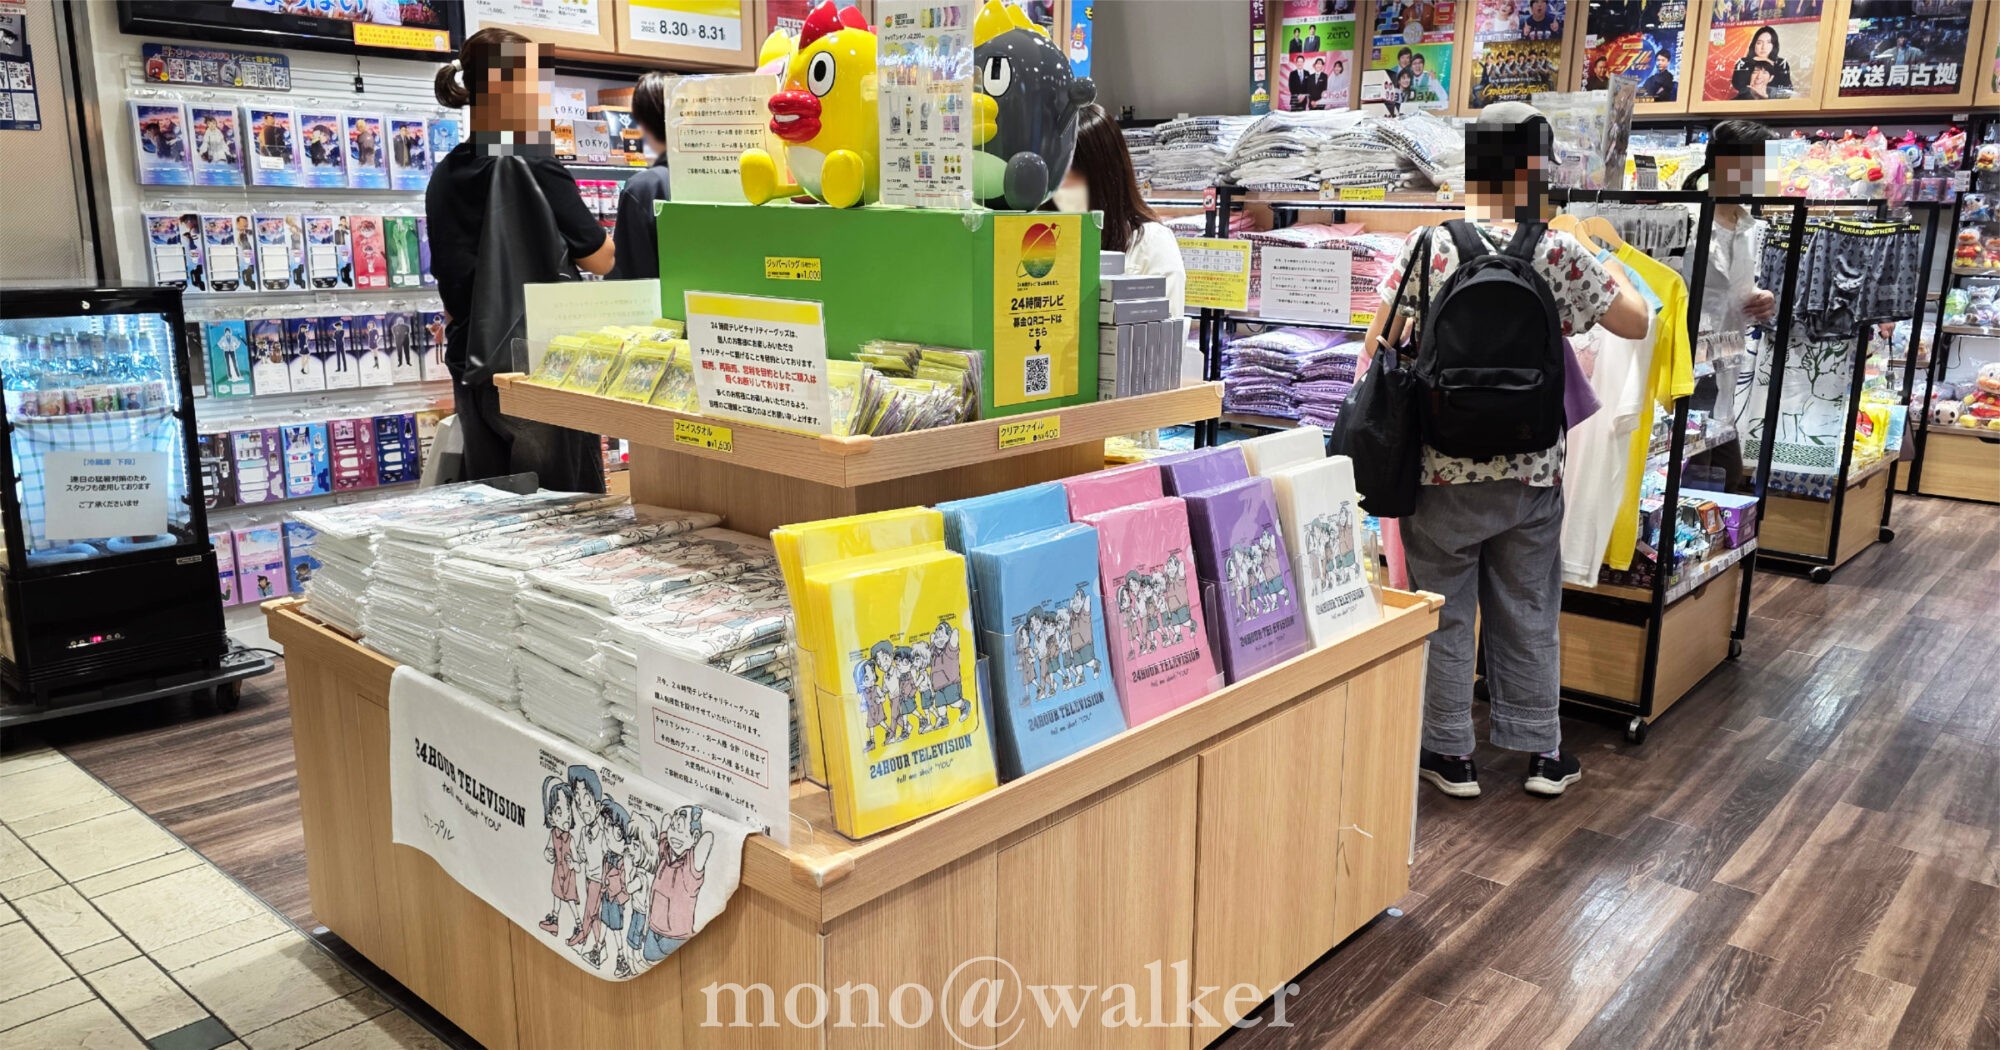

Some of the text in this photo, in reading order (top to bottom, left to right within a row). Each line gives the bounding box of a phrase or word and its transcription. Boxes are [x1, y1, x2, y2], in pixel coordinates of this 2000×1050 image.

[659, 19, 689, 37] 8.30
[698, 25, 726, 41] 8.31
[1326, 30, 1351, 40] zero
[1839, 62, 1958, 88] 放送局占拠
[555, 105, 585, 117] TOKYO
[578, 138, 609, 149] TOKYO
[588, 153, 608, 162] NEW
[1010, 294, 1065, 311] 24時間テレビ
[1013, 314, 1062, 328] 募金QRコードは
[1028, 327, 1047, 338] こちら
[675, 421, 713, 437] フェイスタオル
[1000, 421, 1045, 437] クリアファイル
[66, 483, 151, 492] スタッフも使用しております
[78, 499, 140, 509] ご了承くださいませ
[1132, 650, 1201, 683] 24HOUR TELEVISION
[1028, 691, 1105, 732] 24HOUR TELEVISION
[729, 743, 741, 753] 合計
[869, 734, 973, 779] 24HOUR TELEVISION
[415, 737, 526, 828] 24HOUR TELEVISION
[442, 781, 455, 797] tell
[464, 802, 480, 818] about
[423, 812, 455, 841] サンプル
